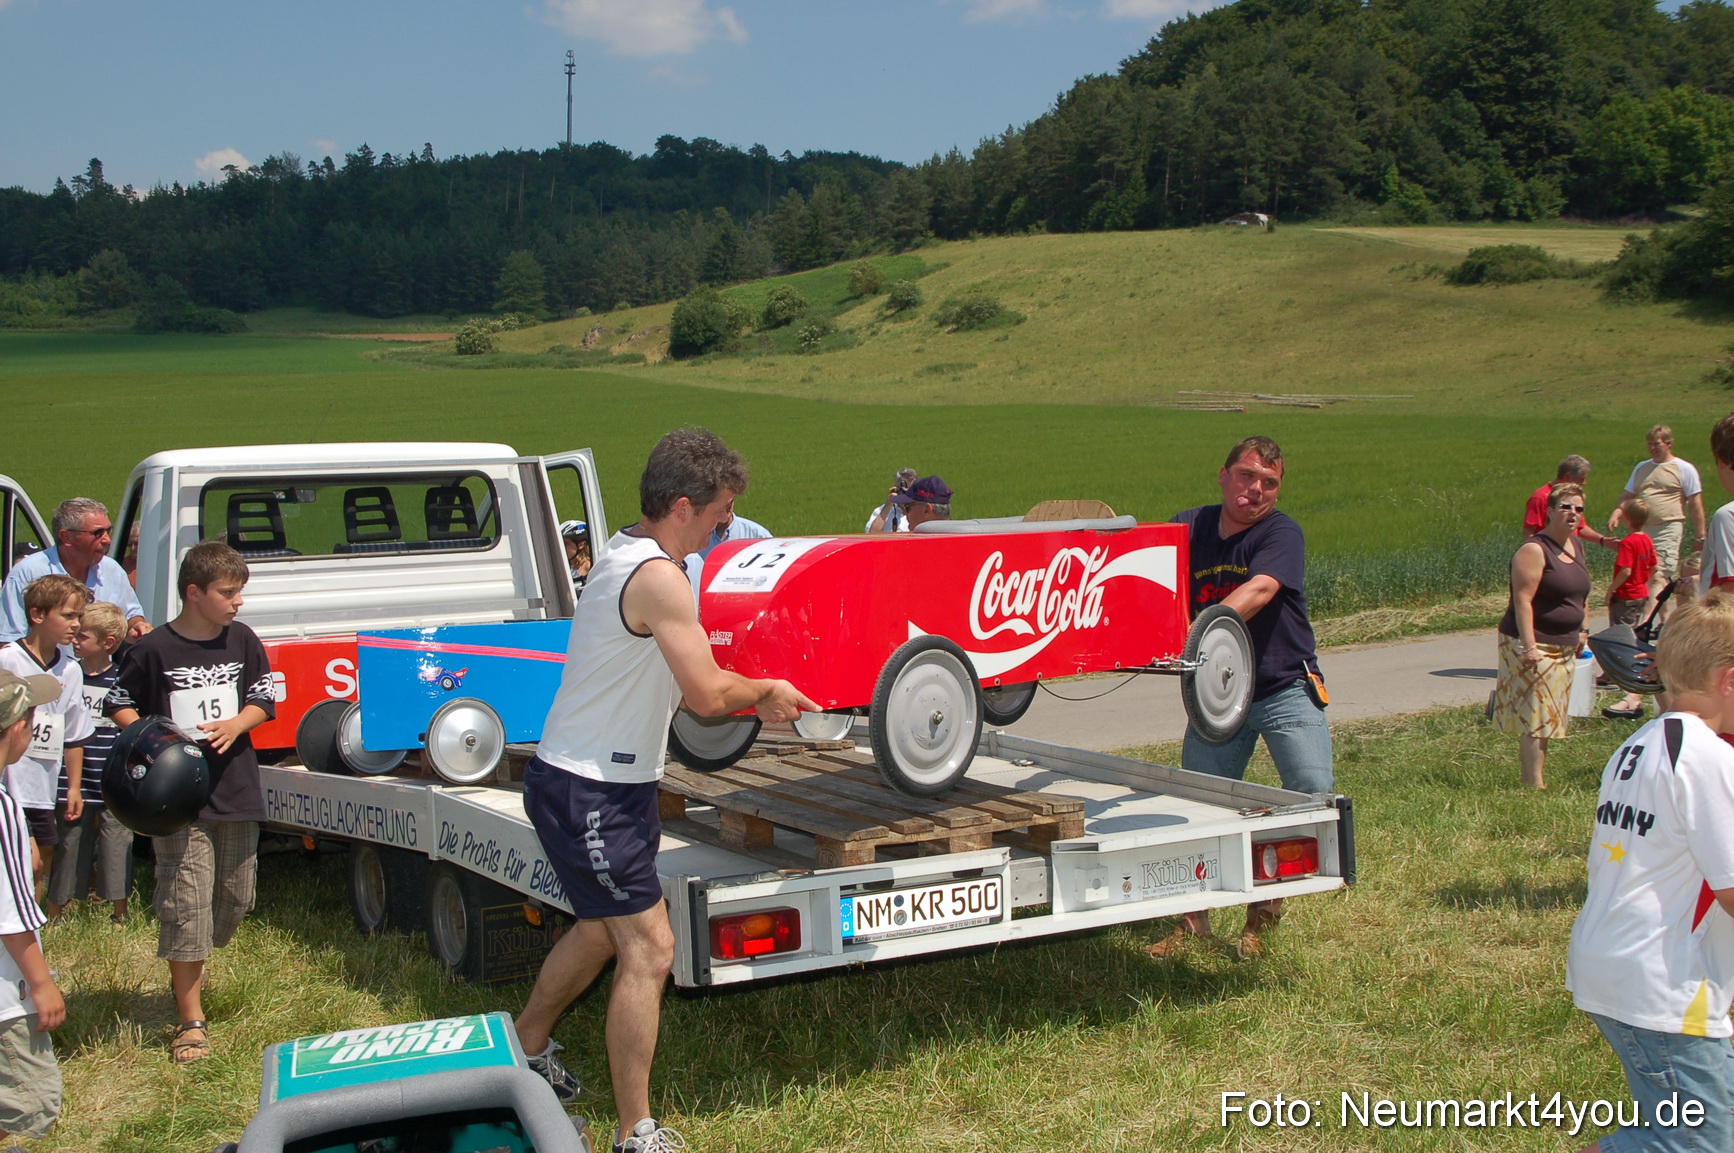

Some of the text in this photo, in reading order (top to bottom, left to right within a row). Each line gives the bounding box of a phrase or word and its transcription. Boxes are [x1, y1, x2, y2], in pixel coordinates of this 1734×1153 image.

[738, 553, 786, 568] J 2
[969, 545, 1109, 640] Coca-Cola
[324, 658, 360, 700] S
[197, 698, 222, 720] 15
[32, 723, 53, 743] 45
[1613, 745, 1645, 781] 13
[267, 788, 418, 847] FAHRZEUGLACKIERUNG
[438, 821, 459, 855] Die
[461, 830, 502, 873] Profis
[503, 848, 527, 883] für
[857, 896, 891, 930] NM
[911, 889, 945, 922] KR
[952, 882, 998, 916] 500
[329, 1025, 476, 1064] RUND
